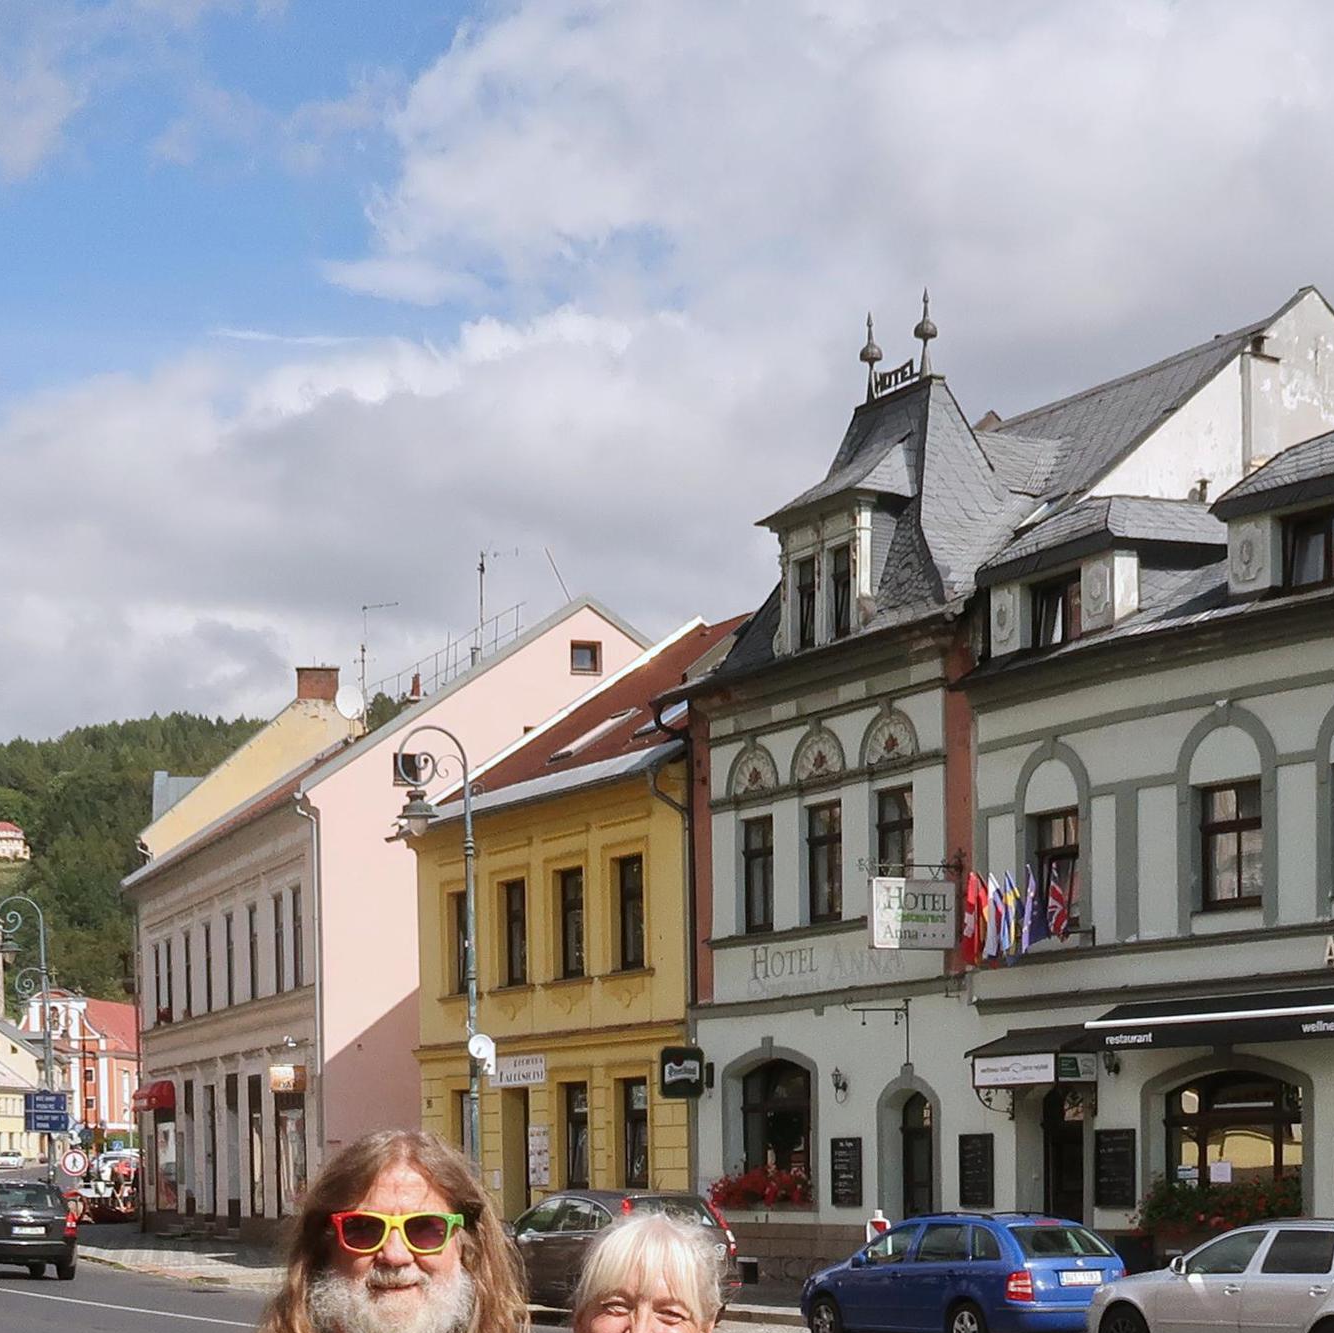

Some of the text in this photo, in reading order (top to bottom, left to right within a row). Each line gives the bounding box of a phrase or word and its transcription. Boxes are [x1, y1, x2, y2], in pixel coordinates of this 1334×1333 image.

[883, 887, 953, 912] HOTEL
[881, 924, 919, 940] Anna
[750, 945, 819, 981] HOTEL
[1105, 1032, 1153, 1045] restaurant
